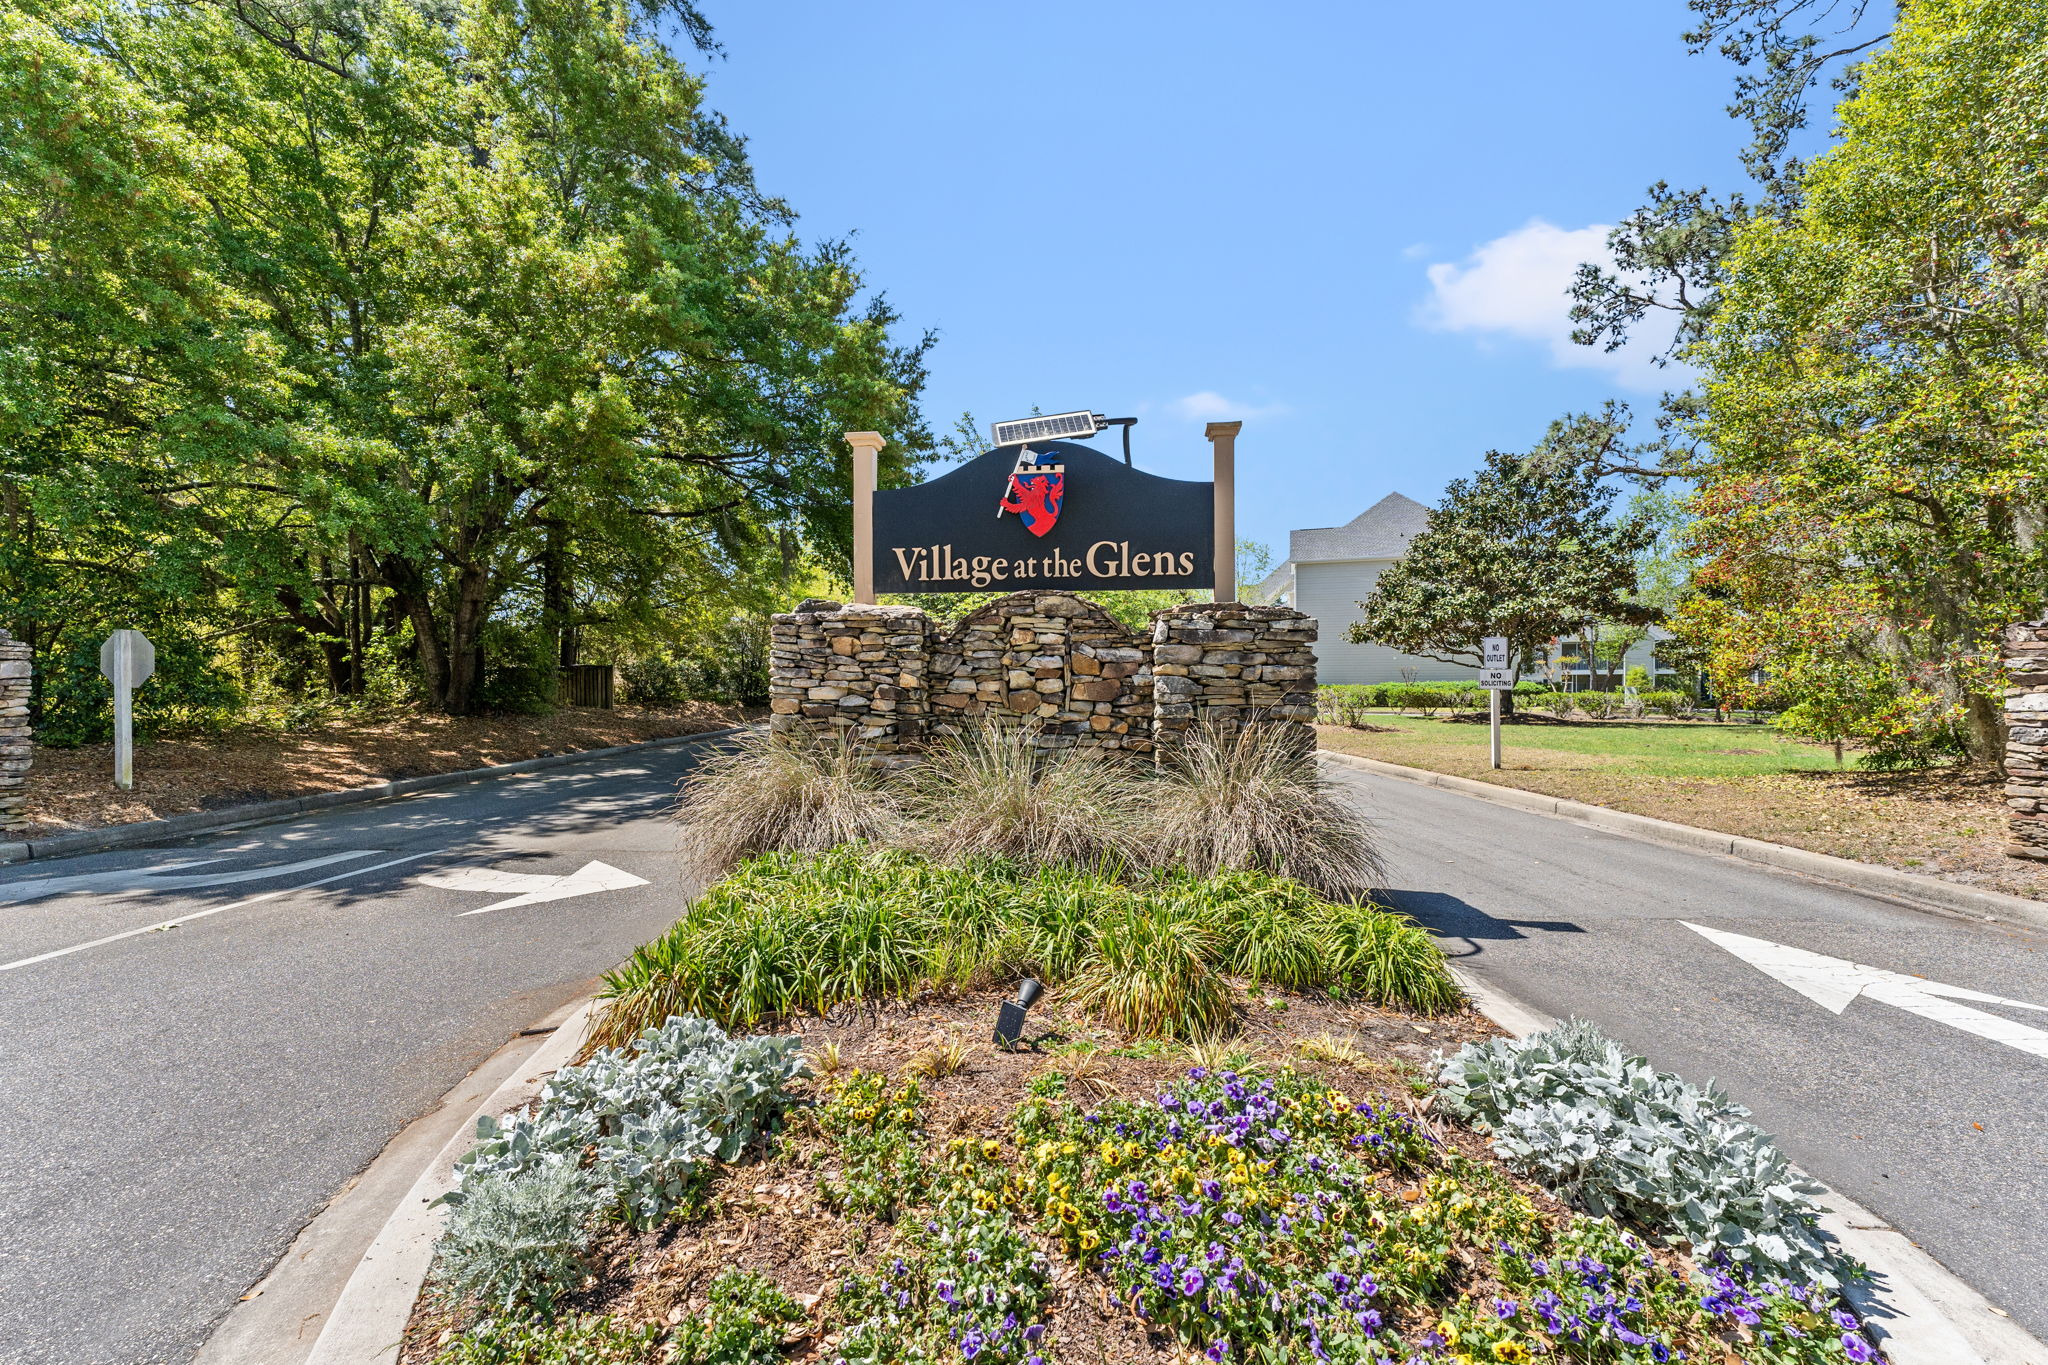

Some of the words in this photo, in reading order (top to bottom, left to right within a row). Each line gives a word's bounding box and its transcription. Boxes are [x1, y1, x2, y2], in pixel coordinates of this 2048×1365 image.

[892, 543, 1009, 588] Village
[1014, 557, 1038, 578] at
[1042, 547, 1082, 578] the
[1086, 540, 1194, 578] Glens
[1486, 654, 1505, 662] OUTLET
